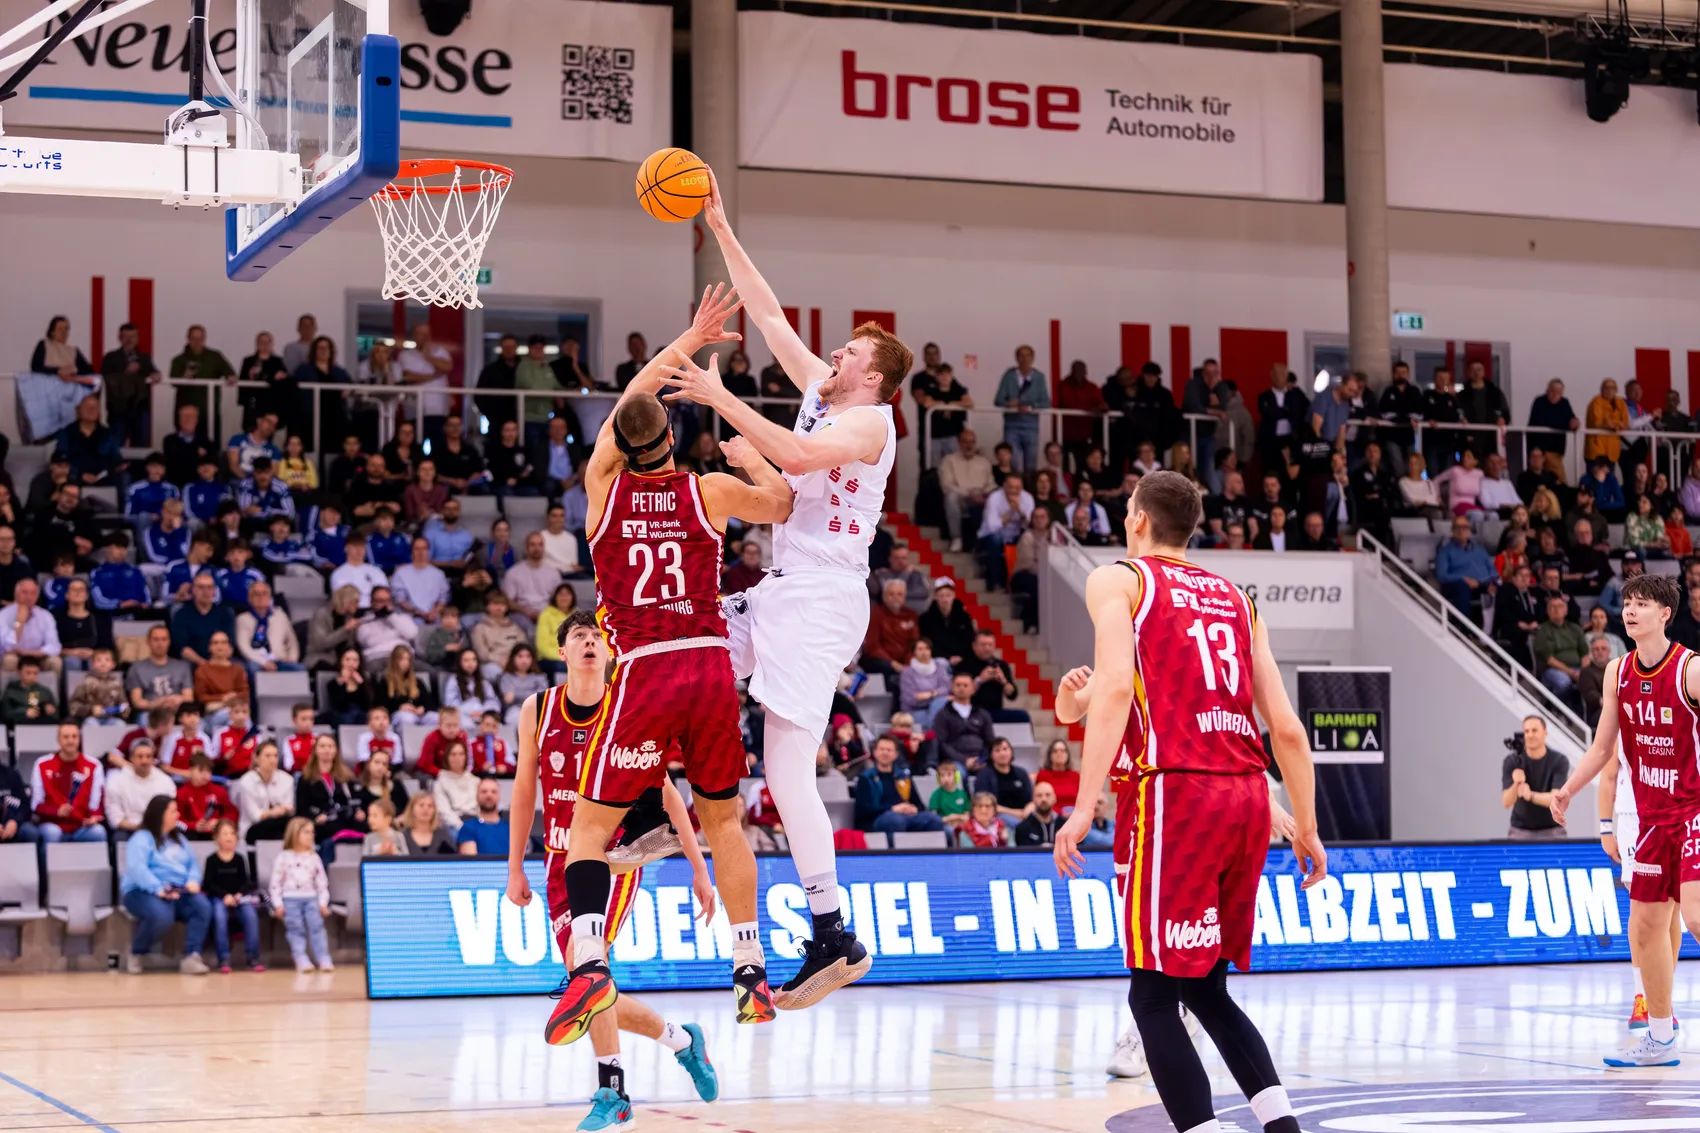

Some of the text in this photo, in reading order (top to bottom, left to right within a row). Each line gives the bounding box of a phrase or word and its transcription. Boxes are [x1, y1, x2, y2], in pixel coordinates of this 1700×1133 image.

[840, 49, 1081, 132] brose
[1104, 88, 1232, 117] Technik für
[1105, 116, 1236, 144] Automobile
[631, 491, 676, 512] PETRIC
[649, 519, 681, 529] VR-Bank
[649, 529, 688, 539] Würzburg
[628, 541, 686, 607] 23
[1265, 584, 1342, 603] arena
[1187, 618, 1240, 697] 13
[1314, 713, 1377, 728] BARMER
[1636, 700, 1657, 726] 14
[610, 742, 663, 770] Webers
[449, 889, 562, 966] VO
[766, 881, 945, 959] SIEL
[988, 879, 1060, 952] IN
[1252, 870, 1457, 945] ALBZEIT
[1500, 867, 1623, 938] ZUM
